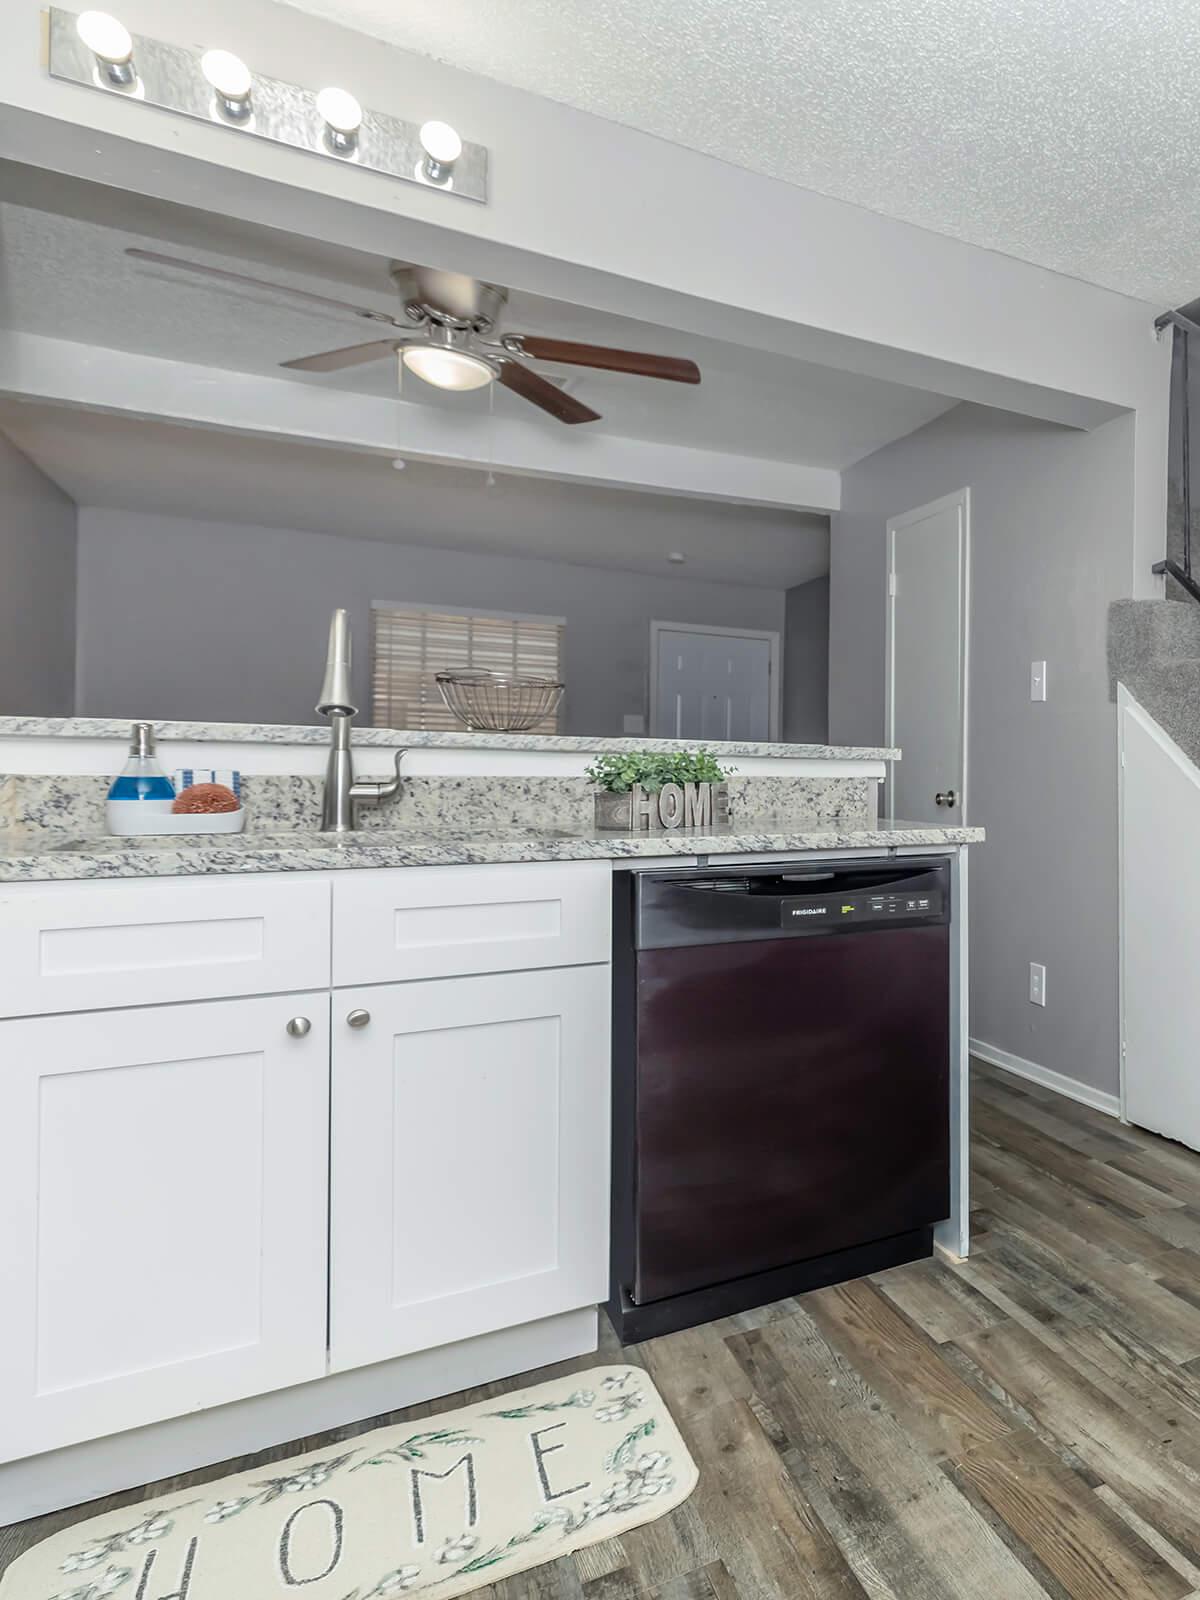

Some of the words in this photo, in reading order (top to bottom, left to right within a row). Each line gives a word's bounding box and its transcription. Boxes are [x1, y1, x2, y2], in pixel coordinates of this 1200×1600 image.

[632, 782, 728, 830] HOME
[792, 907, 827, 916] FRIGIDAIRE
[134, 1421, 591, 1600] HOME
